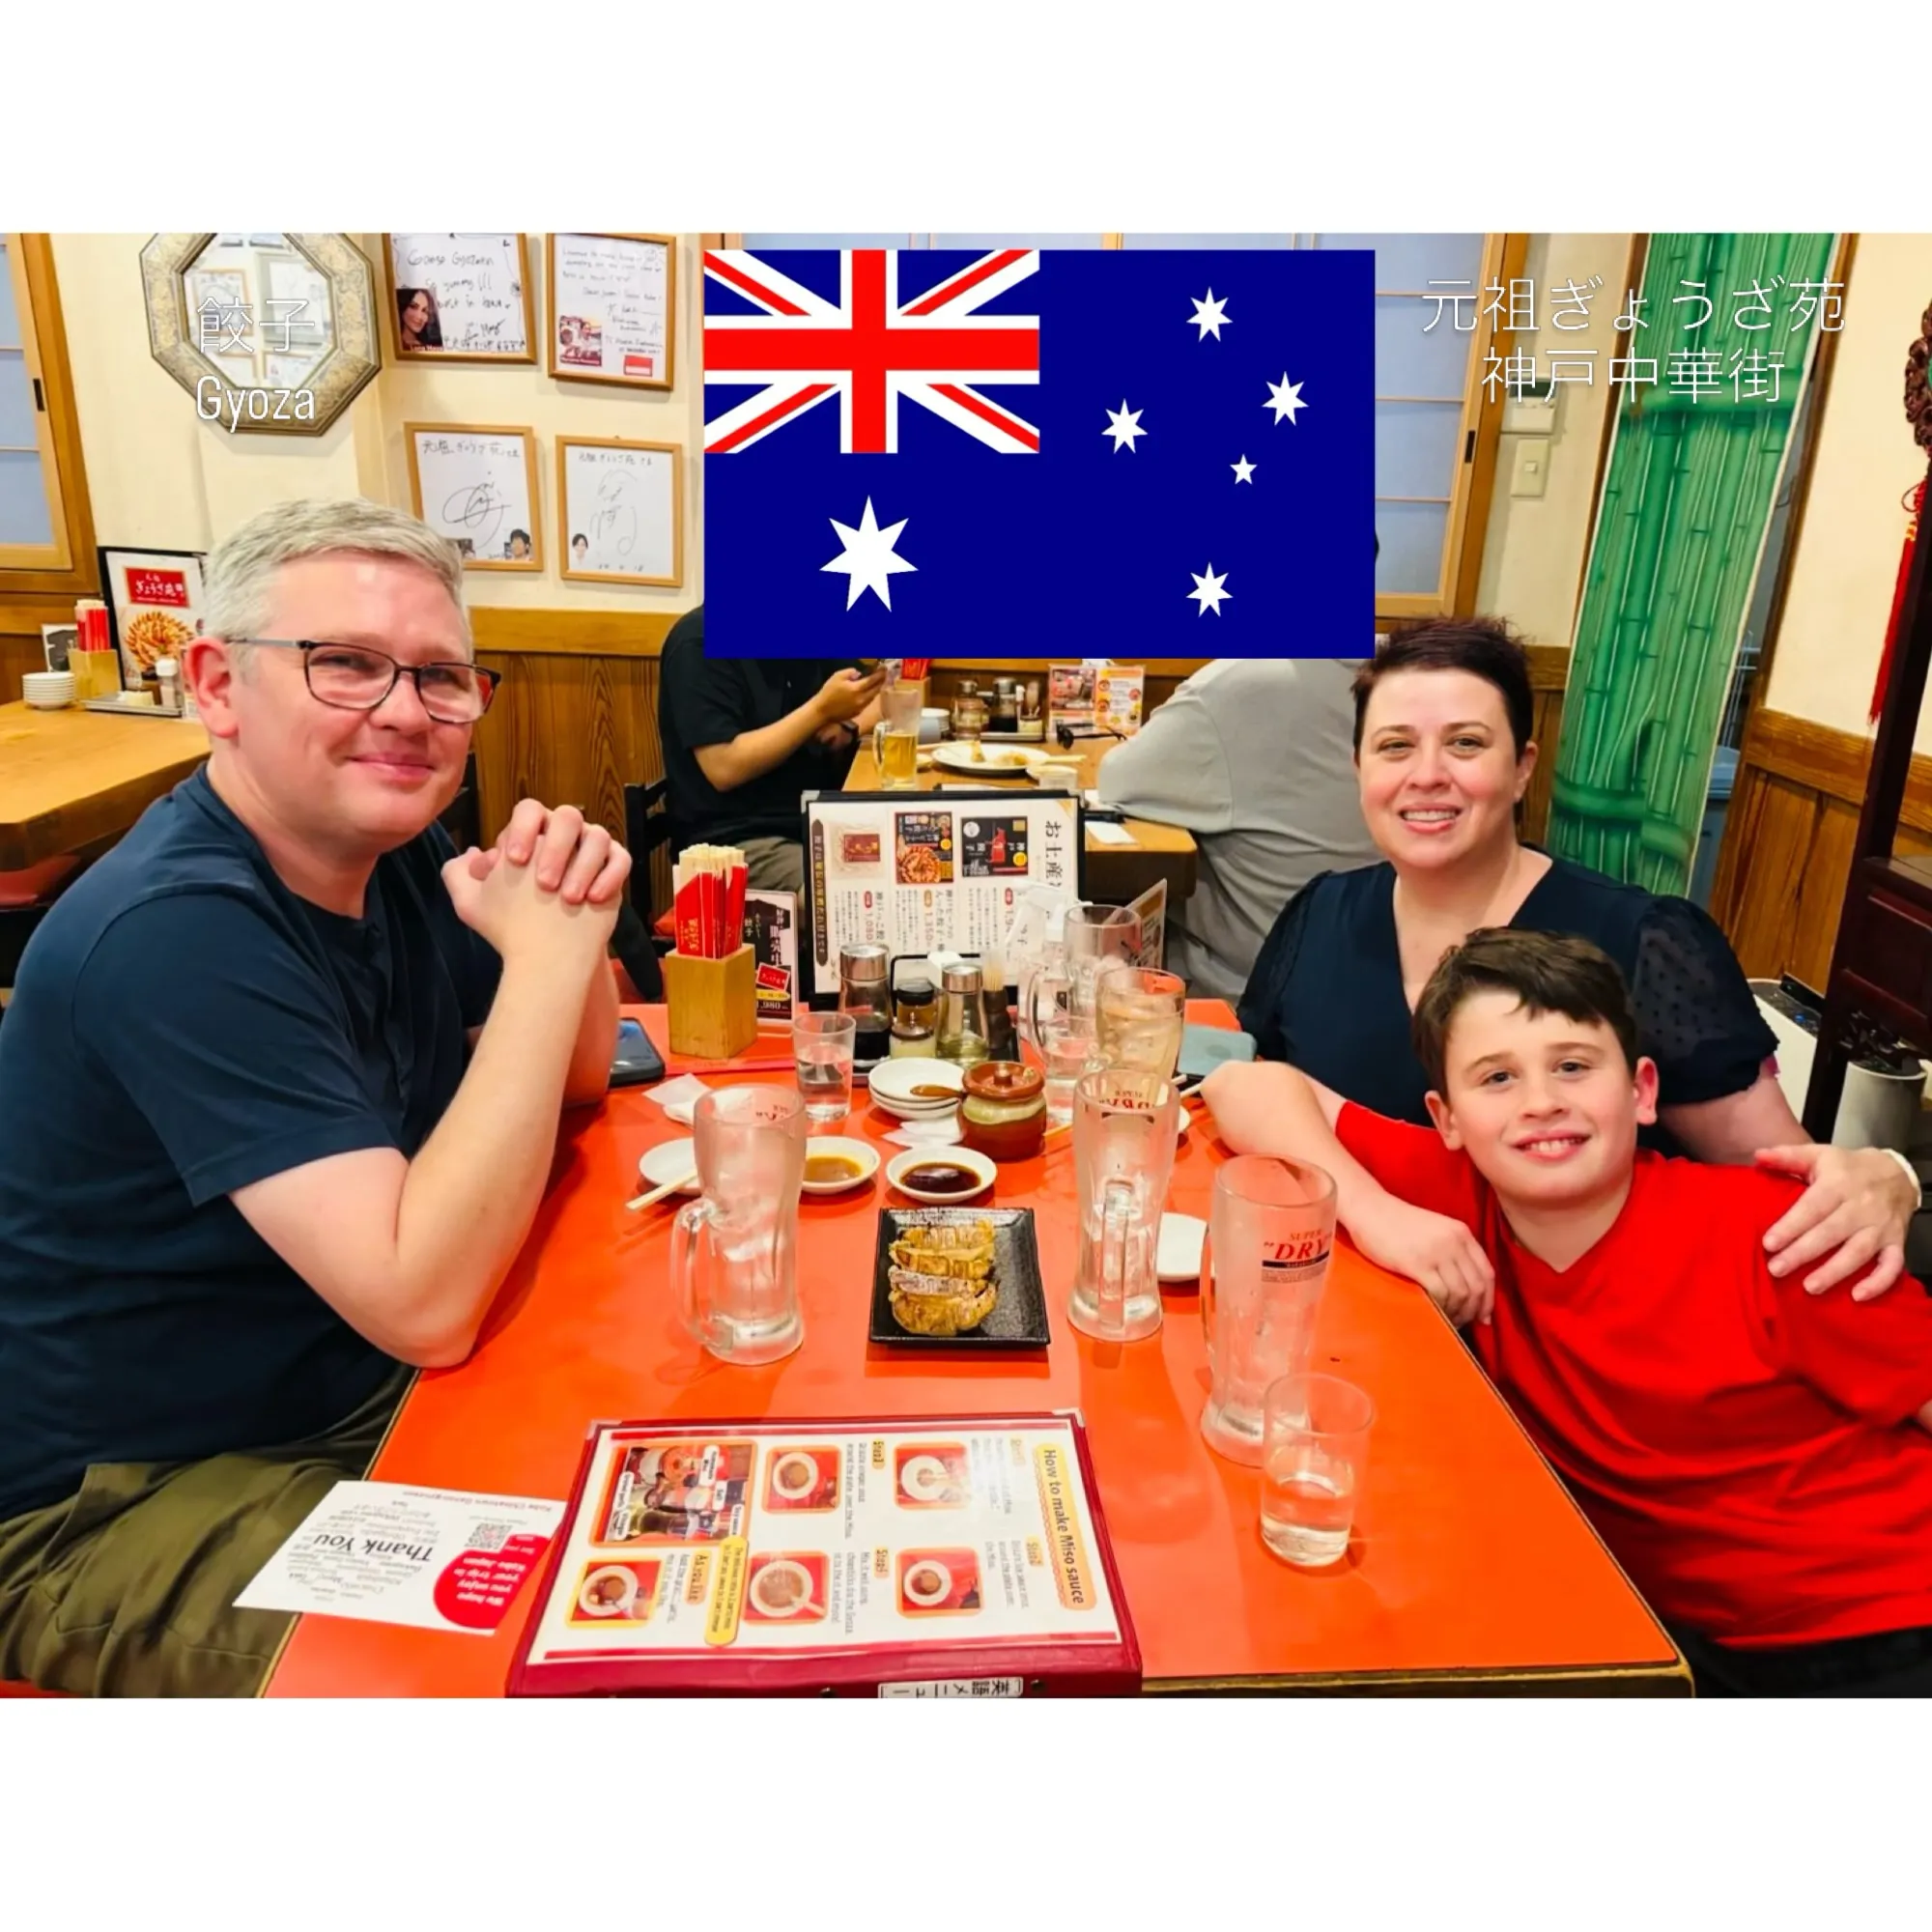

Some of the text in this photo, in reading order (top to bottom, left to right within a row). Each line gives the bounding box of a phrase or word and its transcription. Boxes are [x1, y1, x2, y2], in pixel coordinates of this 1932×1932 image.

[1043, 1449, 1085, 1605] How to make Miso sauce
[312, 1534, 433, 1562] Thank You
[463, 1558, 526, 1572] Kobe Japan
[467, 1568, 490, 1579] trip
[492, 1573, 520, 1582] your
[689, 1555, 708, 1601] As you like
[457, 1578, 512, 1593] you enjoy
[457, 1592, 504, 1606] We hope
